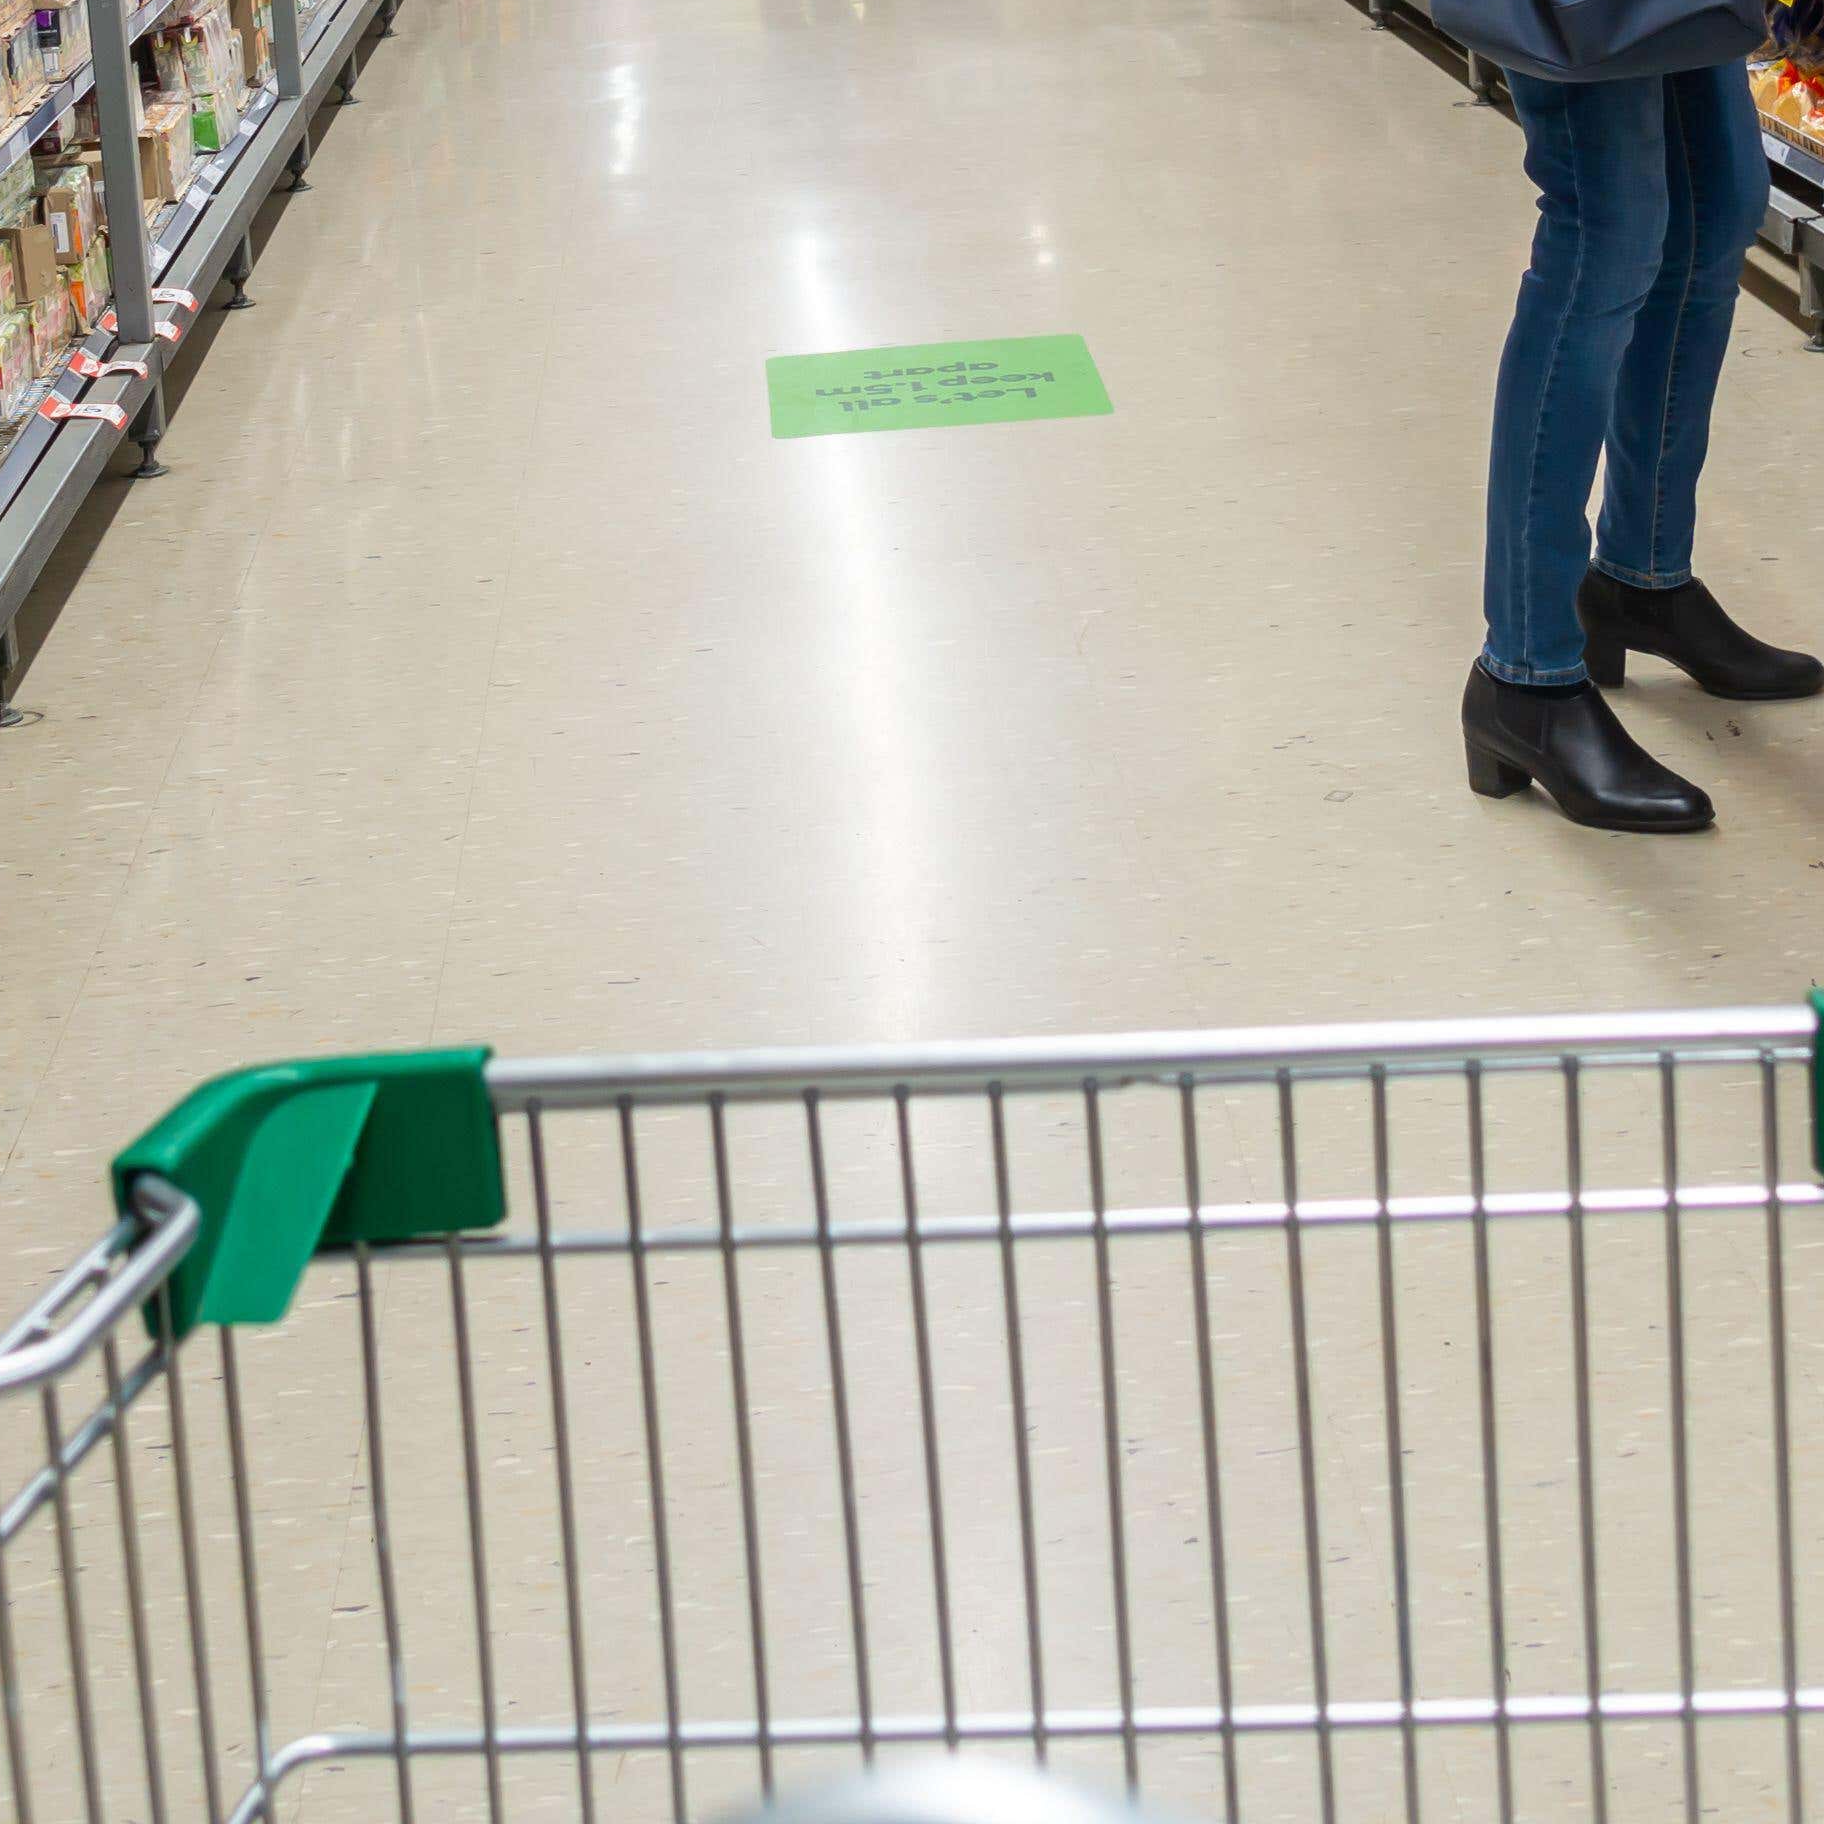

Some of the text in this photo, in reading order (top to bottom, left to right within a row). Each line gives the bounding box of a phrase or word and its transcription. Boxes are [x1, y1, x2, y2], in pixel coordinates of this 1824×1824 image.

[864, 361, 999, 379] apart
[938, 371, 1055, 387] keep
[837, 387, 1037, 412] Let's all
